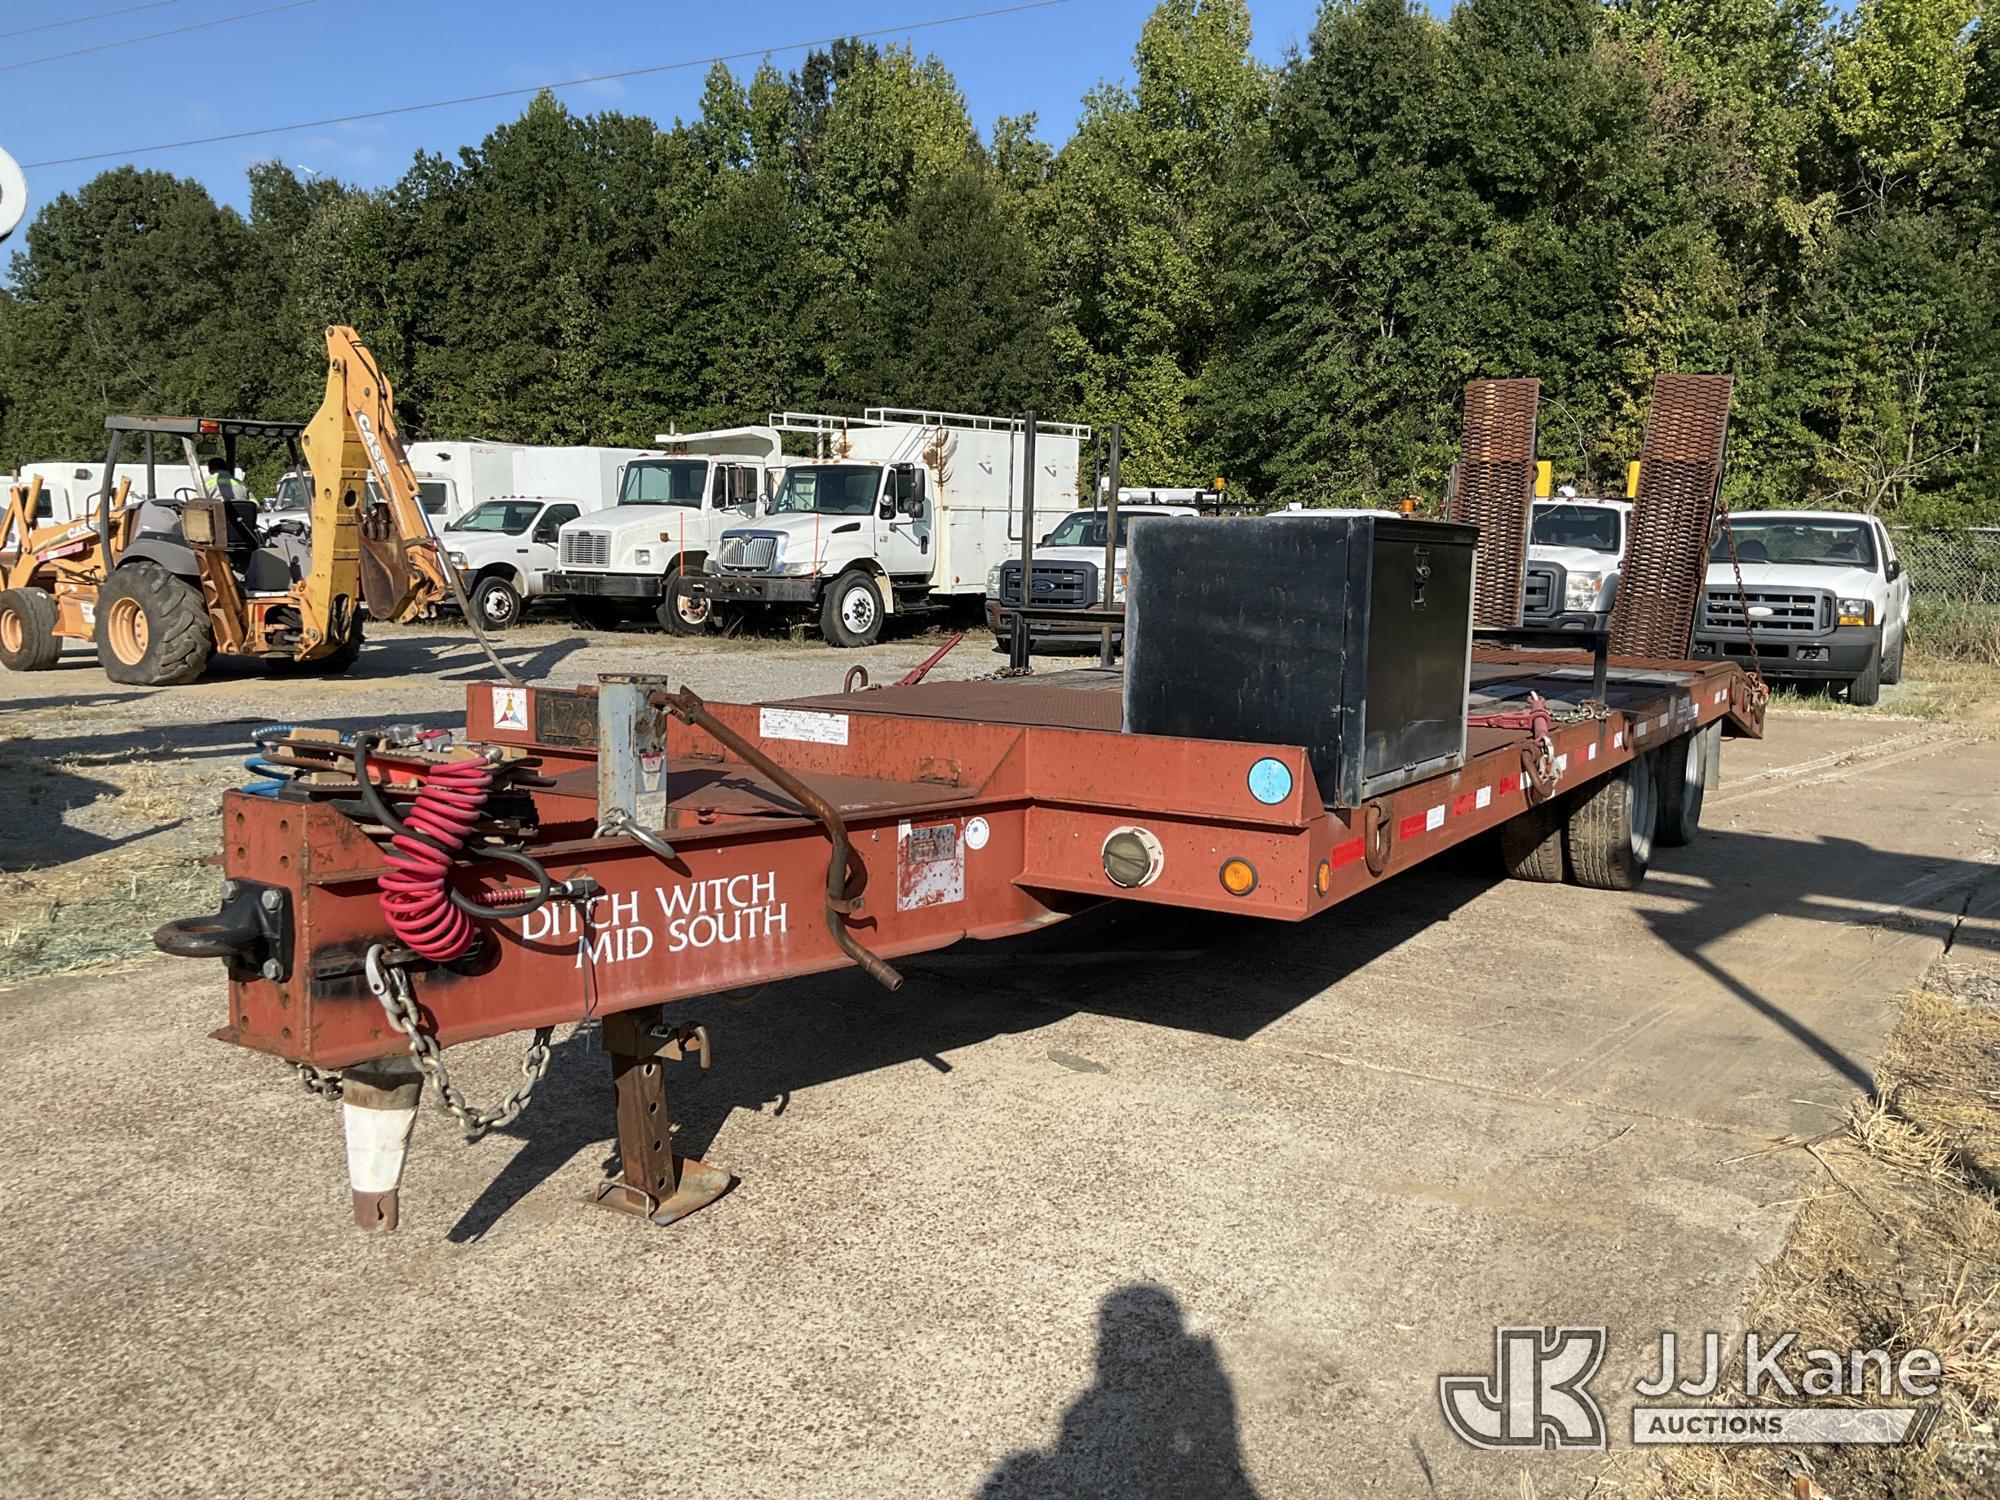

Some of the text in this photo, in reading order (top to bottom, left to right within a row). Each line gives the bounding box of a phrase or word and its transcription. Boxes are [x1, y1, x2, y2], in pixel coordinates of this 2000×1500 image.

[358, 413, 390, 476] CASE
[522, 871, 776, 940] DITCH WITCH
[575, 902, 787, 969] MID SOUTH
